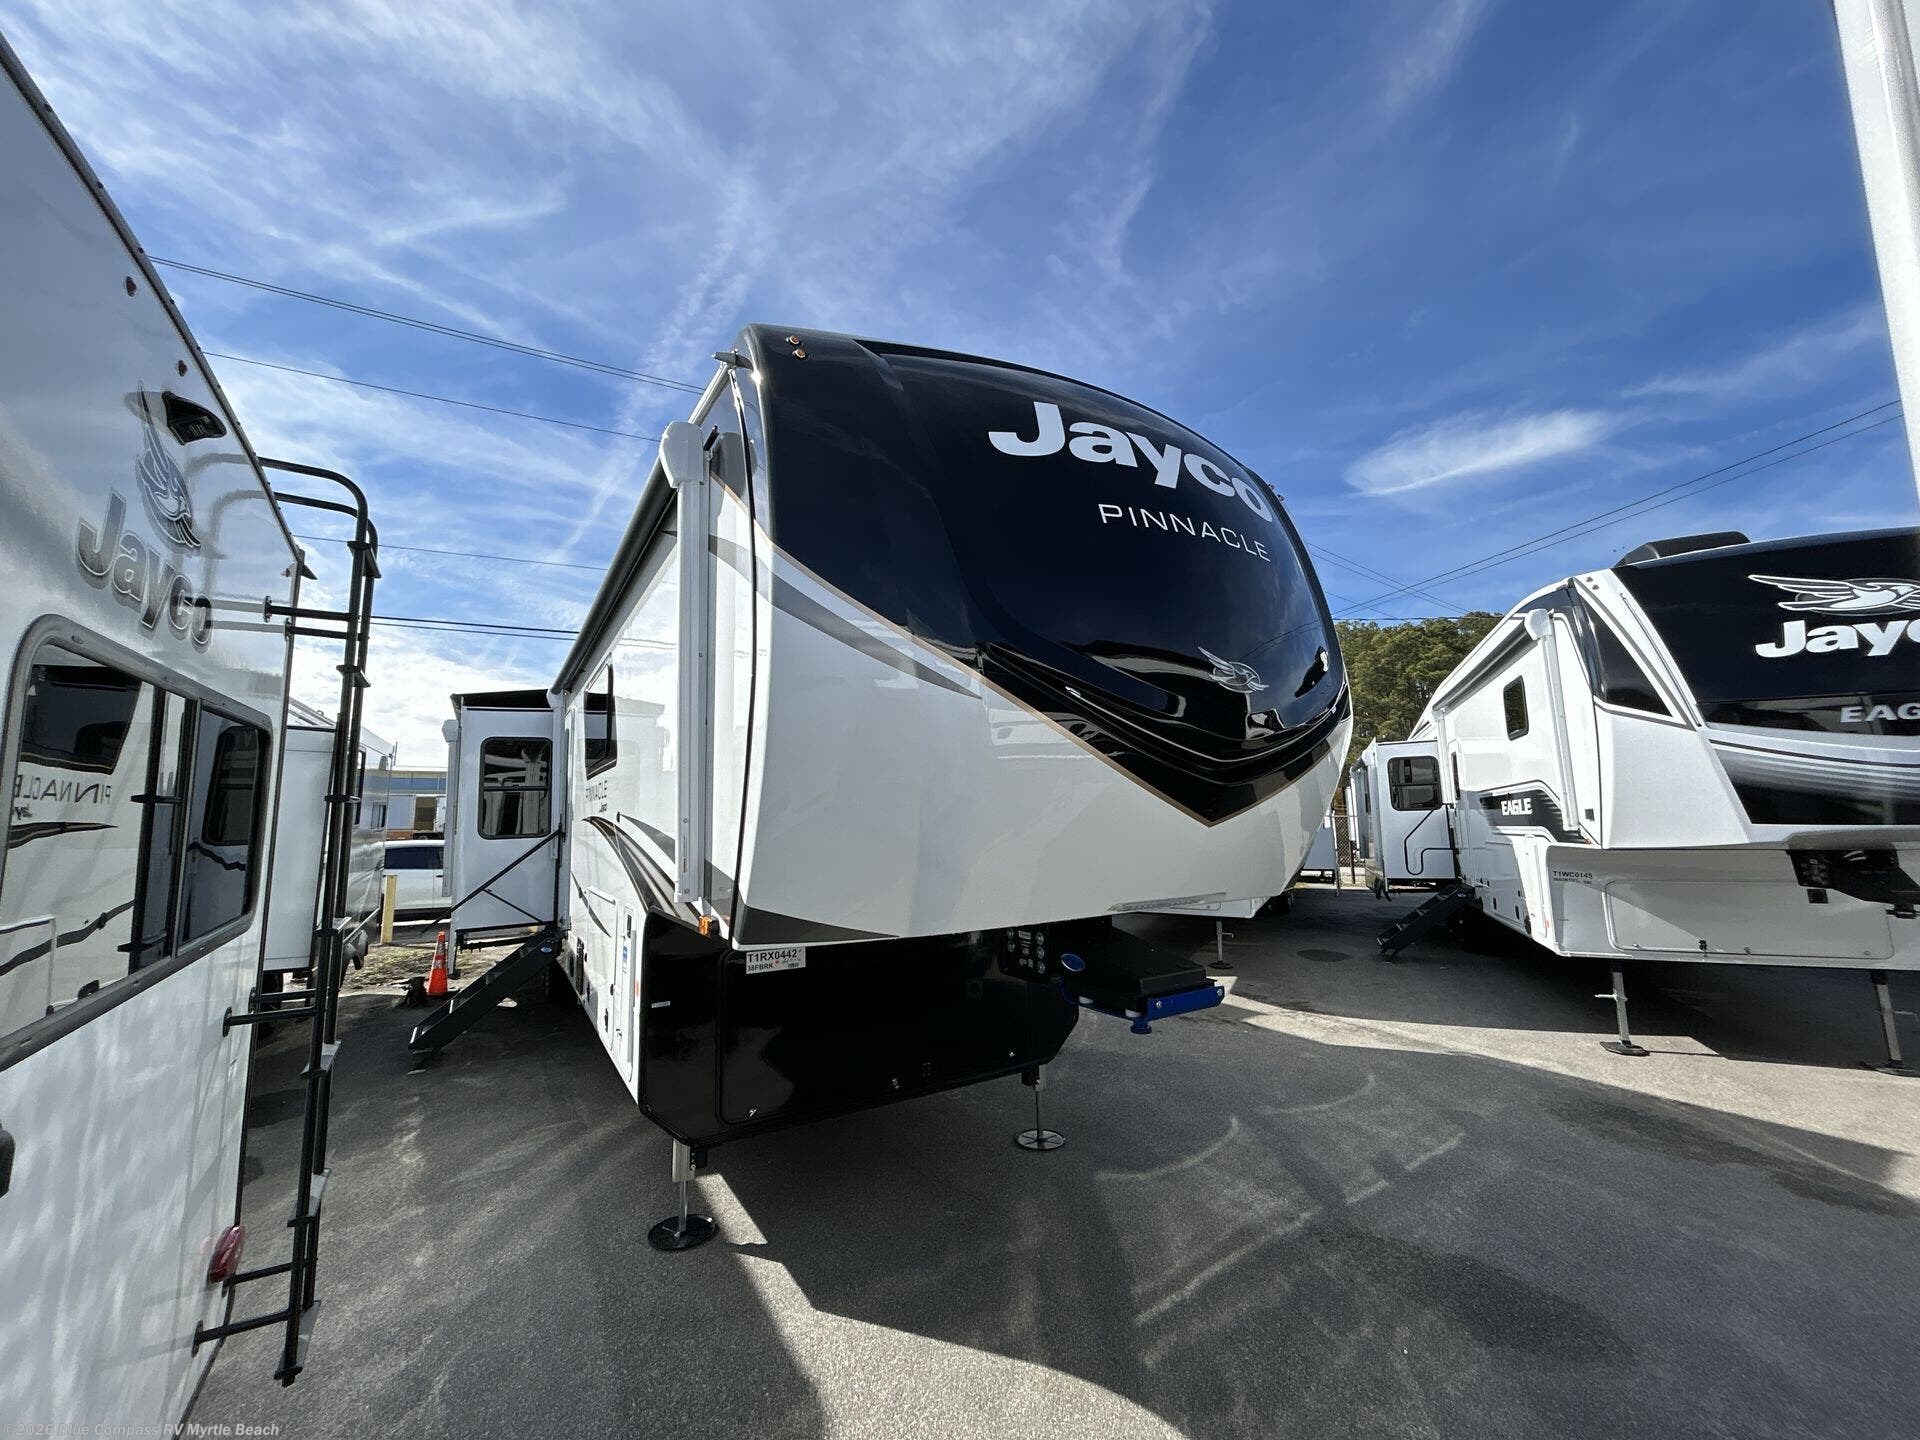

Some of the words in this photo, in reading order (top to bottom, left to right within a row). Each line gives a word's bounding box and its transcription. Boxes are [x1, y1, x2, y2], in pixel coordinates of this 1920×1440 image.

[987, 401, 1273, 523] Jayco
[1098, 503, 1271, 562] PINNACLE
[76, 486, 214, 645] Jayco
[1500, 797, 1533, 816] EAGLE
[1552, 870, 1593, 879] T1WC0145
[747, 949, 798, 963] T1RX0442
